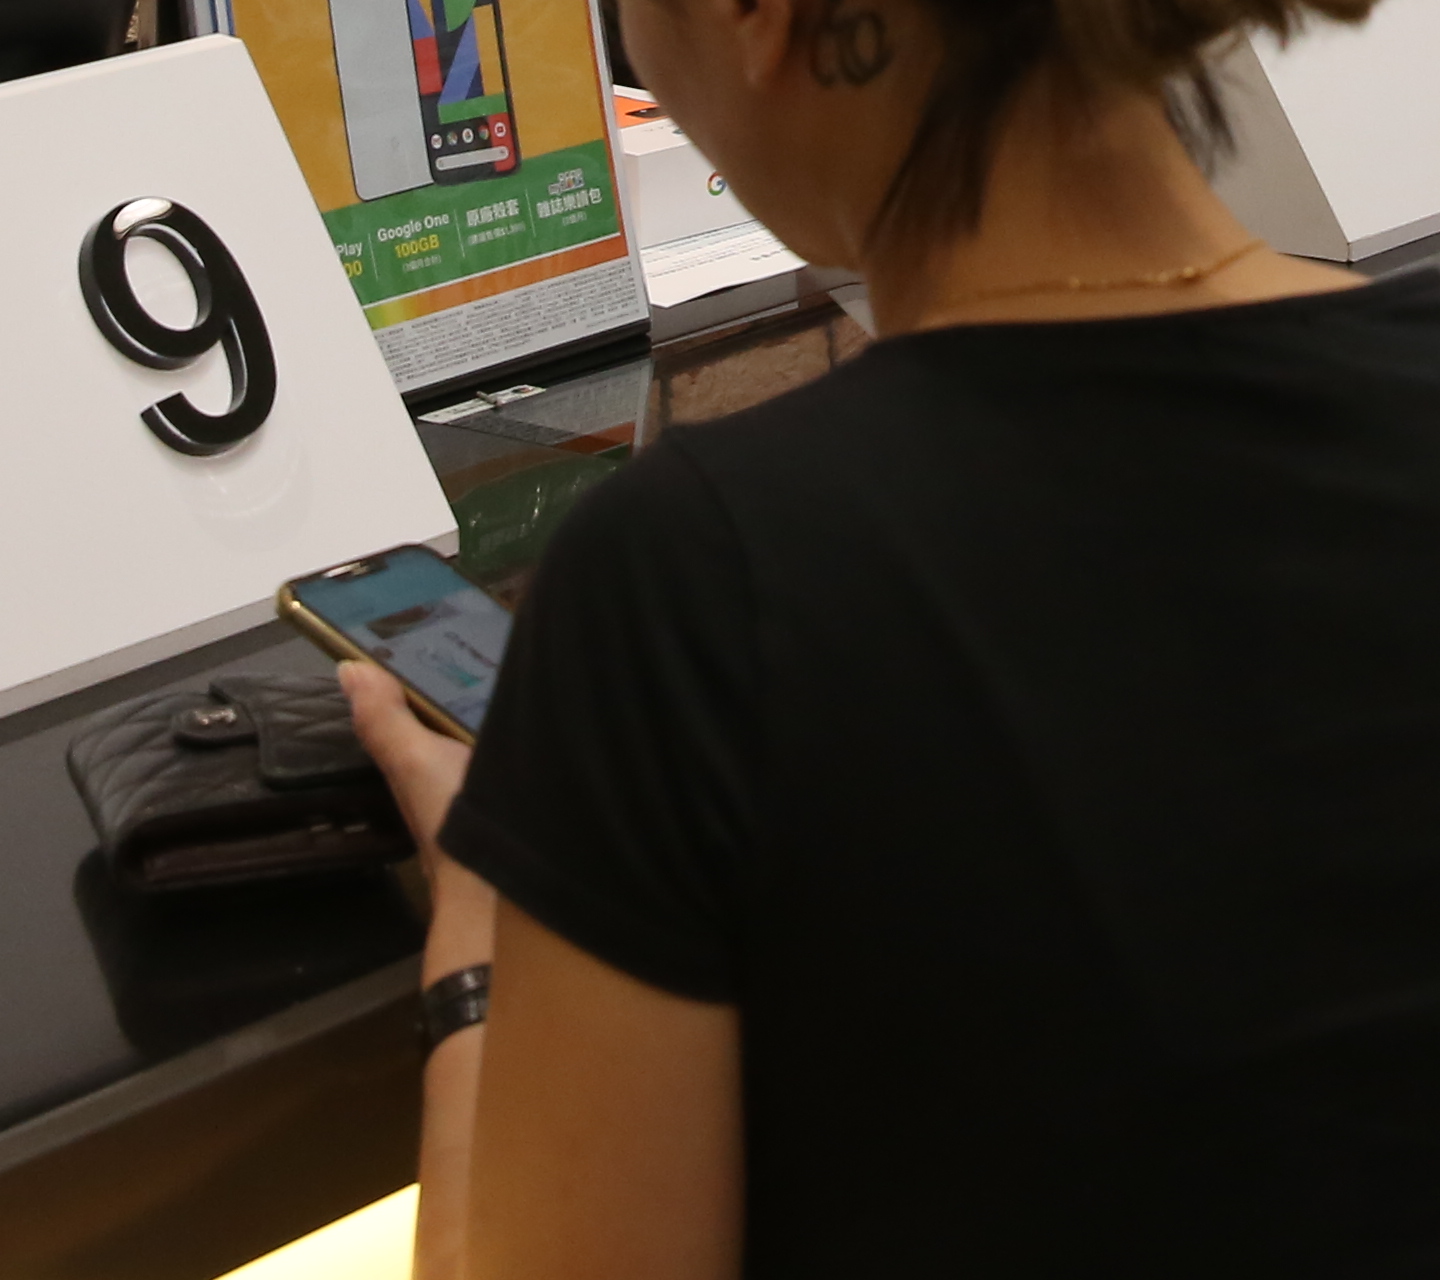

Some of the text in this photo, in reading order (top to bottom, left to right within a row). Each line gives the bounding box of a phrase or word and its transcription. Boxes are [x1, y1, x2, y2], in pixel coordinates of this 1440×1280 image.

[377, 213, 450, 242] Google One
[394, 234, 440, 258] 100GB
[78, 195, 279, 458] 9
